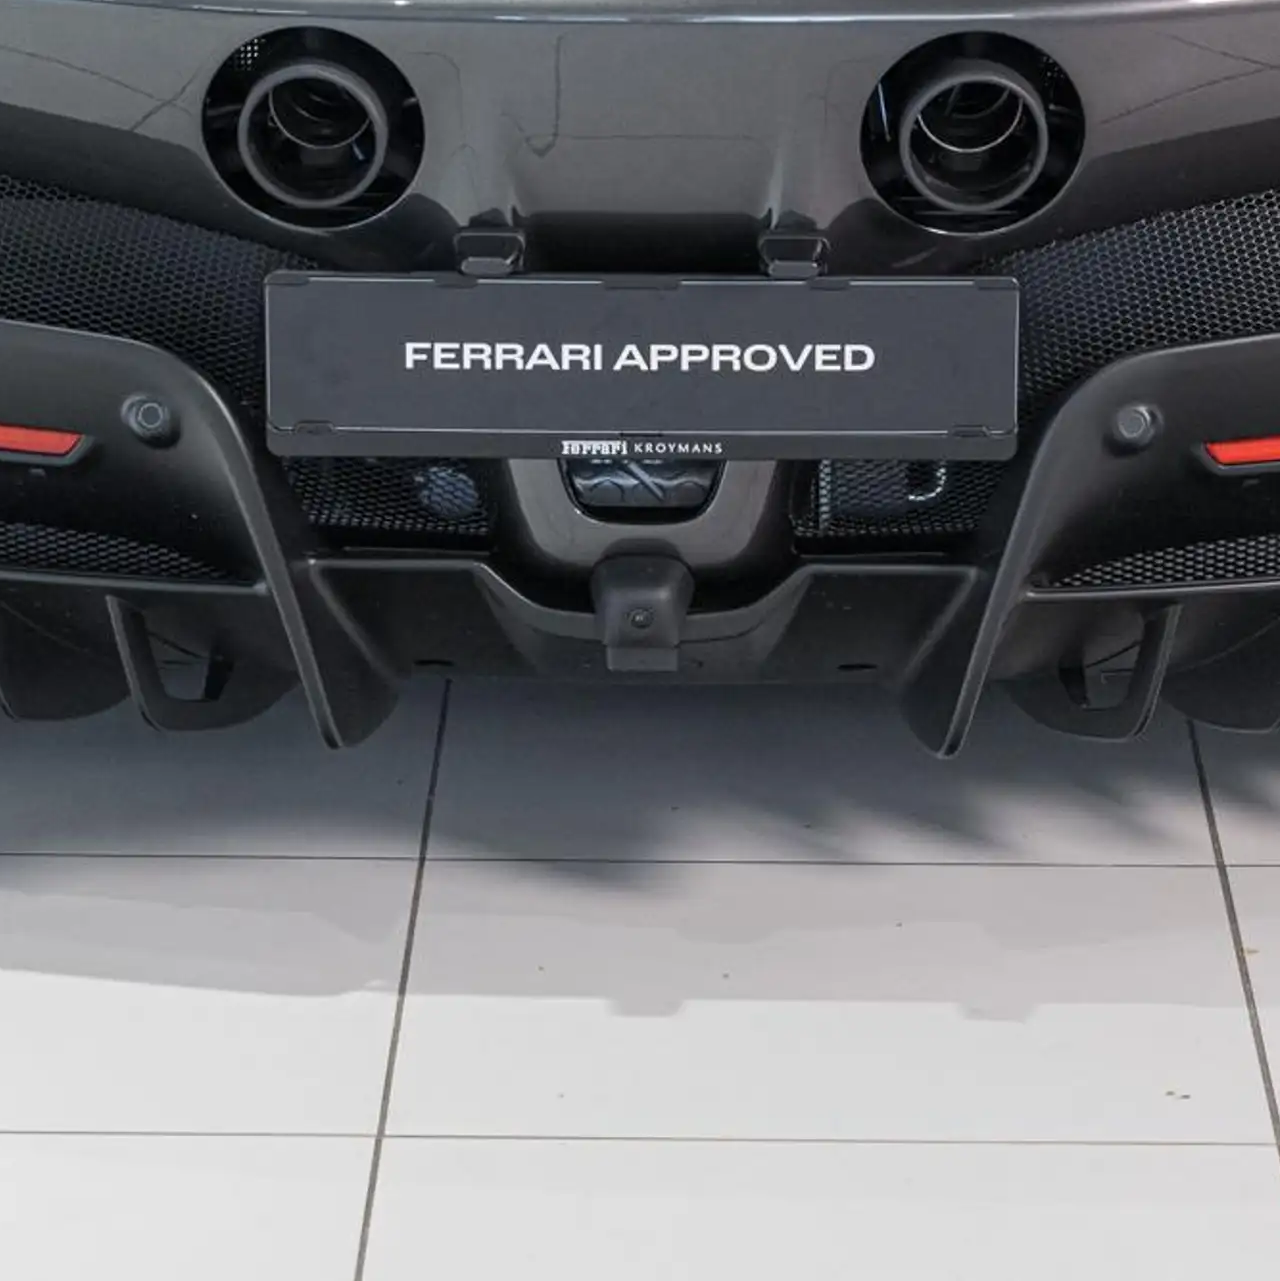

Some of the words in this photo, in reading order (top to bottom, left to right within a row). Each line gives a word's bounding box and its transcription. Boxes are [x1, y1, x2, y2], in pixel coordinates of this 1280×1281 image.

[405, 341, 604, 371] FERRARI
[612, 343, 876, 372] APPROVED
[561, 440, 628, 456] Ferrari
[634, 442, 723, 455] KROYMANS
